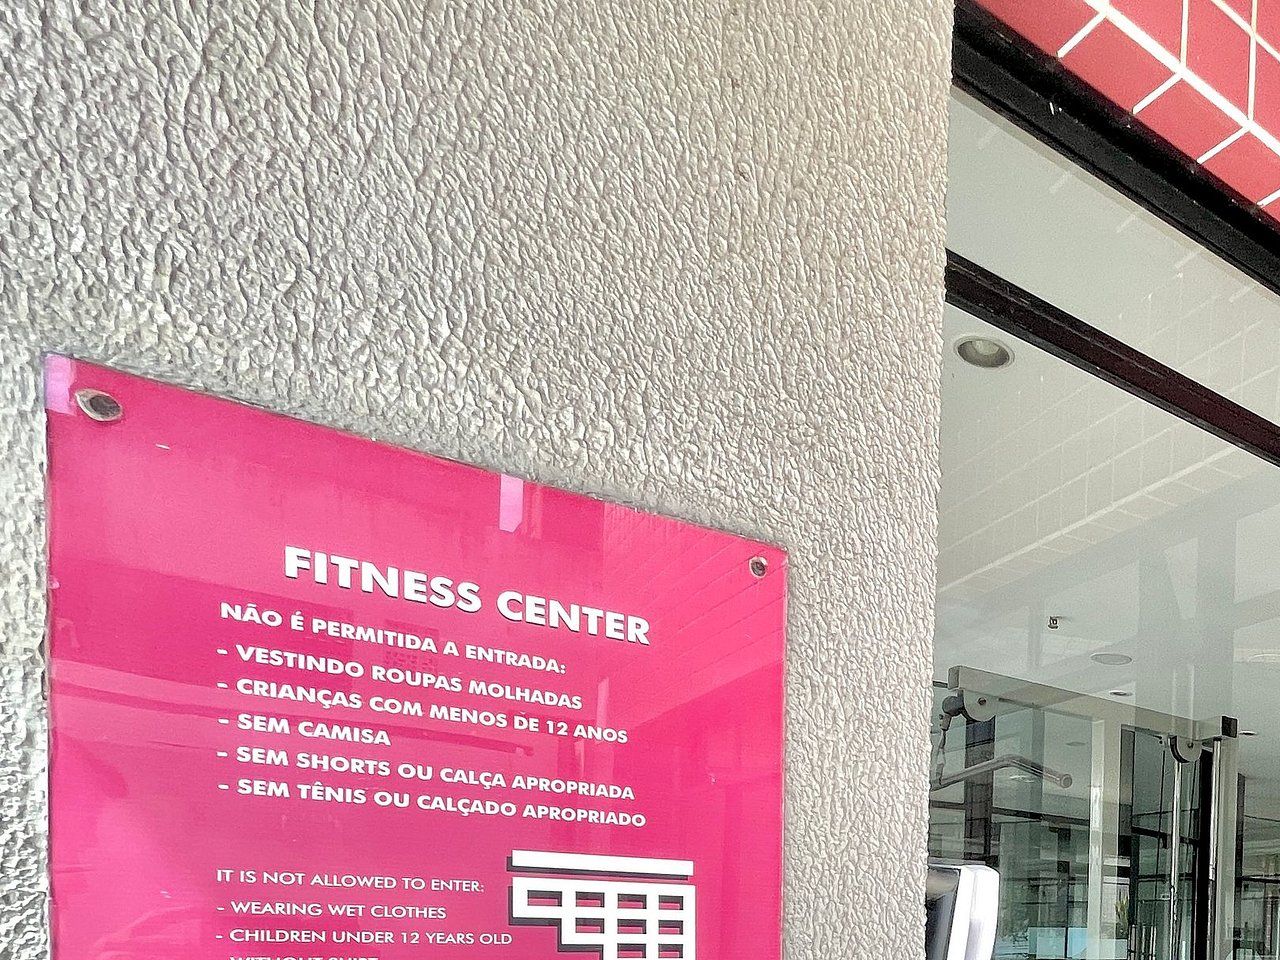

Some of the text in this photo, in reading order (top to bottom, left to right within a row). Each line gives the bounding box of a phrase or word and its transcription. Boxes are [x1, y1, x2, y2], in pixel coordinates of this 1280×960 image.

[284, 545, 650, 645] FITNESS CENTER
[219, 601, 566, 675] NÃO É PERMITIDA A ENTRADA:
[236, 644, 364, 678] VESTINDO
[371, 664, 462, 694] ROUPAS
[469, 680, 582, 710] MOLHADAS
[236, 679, 362, 712] CRIANÇAS
[370, 697, 424, 716] COM
[429, 704, 507, 727] MENOS
[513, 715, 539, 733] DE
[546, 720, 569, 736] 12
[573, 723, 627, 743] ANOS
[237, 714, 290, 734] SEM
[298, 721, 391, 746] CAMISA
[237, 747, 288, 766] SEM
[296, 753, 390, 777] SHORTS
[398, 763, 432, 781] OU
[440, 768, 507, 789] CALÇA
[512, 775, 635, 800] APROPRIADA
[237, 779, 290, 799] SEM
[297, 781, 366, 805] TÊNIS
[374, 791, 410, 808] OU
[417, 795, 517, 817] CALÇADO
[523, 805, 646, 827] APROPRIADO
[216, 869, 484, 893] IT IS NOT ALLOWED TO ENTER:
[231, 901, 323, 917] WEARING
[327, 904, 365, 917] WET
[371, 905, 447, 919] CLOTHES
[230, 929, 326, 943] CHILDREN
[332, 930, 394, 944] UNDER
[401, 931, 419, 944] 12
[426, 932, 475, 945] YEARS
[480, 932, 512, 945] OLD
